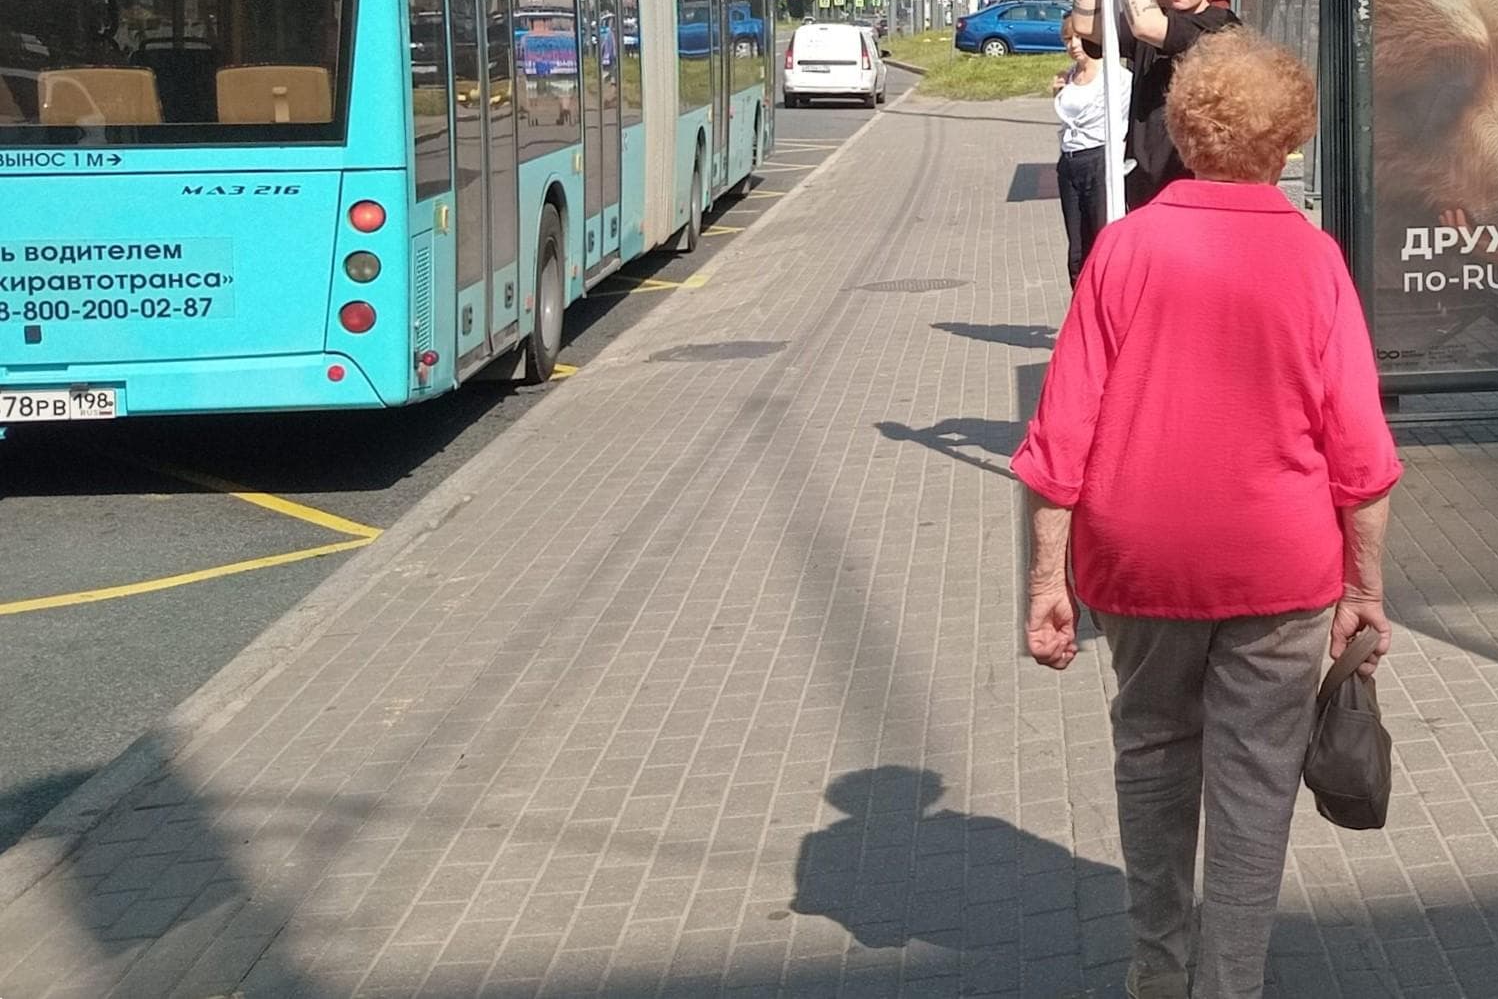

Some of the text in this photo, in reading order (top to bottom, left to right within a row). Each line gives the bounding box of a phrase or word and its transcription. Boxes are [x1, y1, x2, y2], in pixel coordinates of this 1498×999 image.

[74, 153, 80, 167] 1
[87, 153, 103, 167] М
[181, 185, 302, 195] МАЗ 216
[25, 243, 182, 264] водителем
[0, 298, 213, 321] 8-800-200-02-87
[0, 392, 108, 418] 78РВ 198
